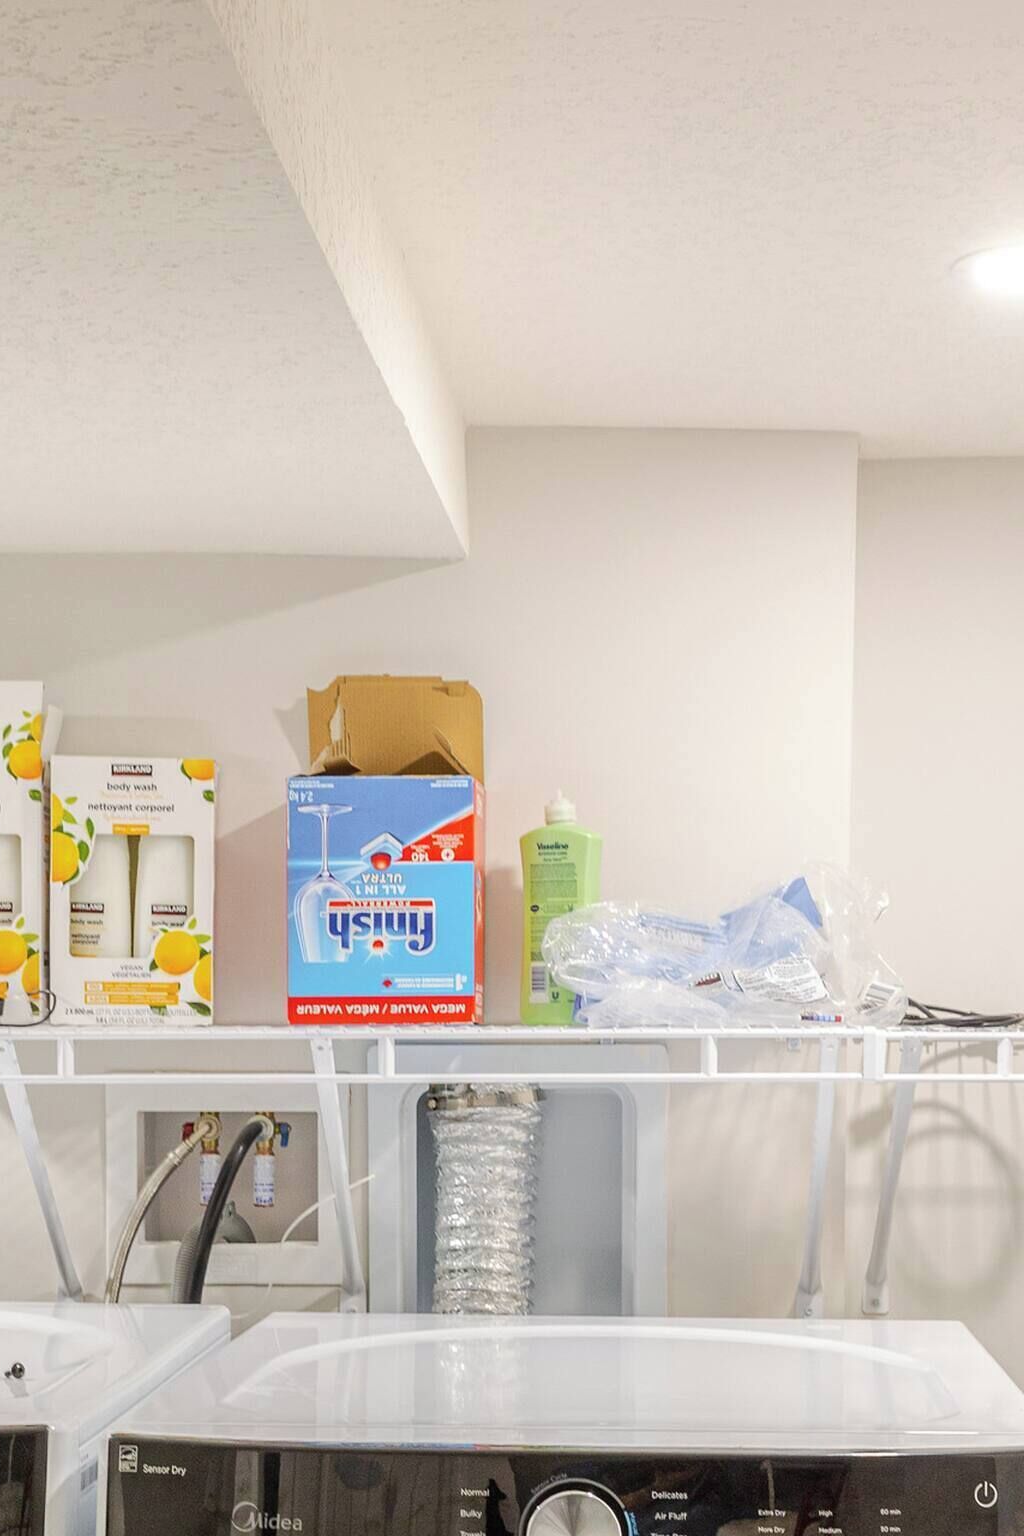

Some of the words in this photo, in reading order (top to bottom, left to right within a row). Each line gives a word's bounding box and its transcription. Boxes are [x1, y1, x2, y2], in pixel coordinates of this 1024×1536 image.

[113, 765, 152, 774] KIRKLAND
[107, 782, 130, 792] body
[134, 783, 157, 791] wash
[88, 804, 132, 812] nettoyant
[136, 804, 174, 812] corporel
[412, 852, 429, 862] 140
[362, 874, 403, 883] ULTRA
[356, 885, 361, 894] 1
[366, 885, 378, 894] IN
[384, 885, 406, 894] ALL
[152, 904, 186, 913] KIRKLAND
[329, 912, 434, 952] finish
[296, 1004, 342, 1015] VALEUR
[346, 1004, 380, 1017] MÉGA
[382, 1003, 389, 1014] /
[390, 1004, 428, 1014] VALUE
[433, 1004, 466, 1014] MEGA
[142, 1464, 170, 1474] Sensor
[172, 1464, 186, 1476] Dry
[460, 1488, 490, 1497] Normal
[651, 1491, 688, 1500] Delicates
[235, 1505, 302, 1532] Midea
[460, 1509, 482, 1519] Bulky
[655, 1512, 667, 1520] Air
[668, 1512, 688, 1520] Fluff
[818, 1510, 833, 1518] High
